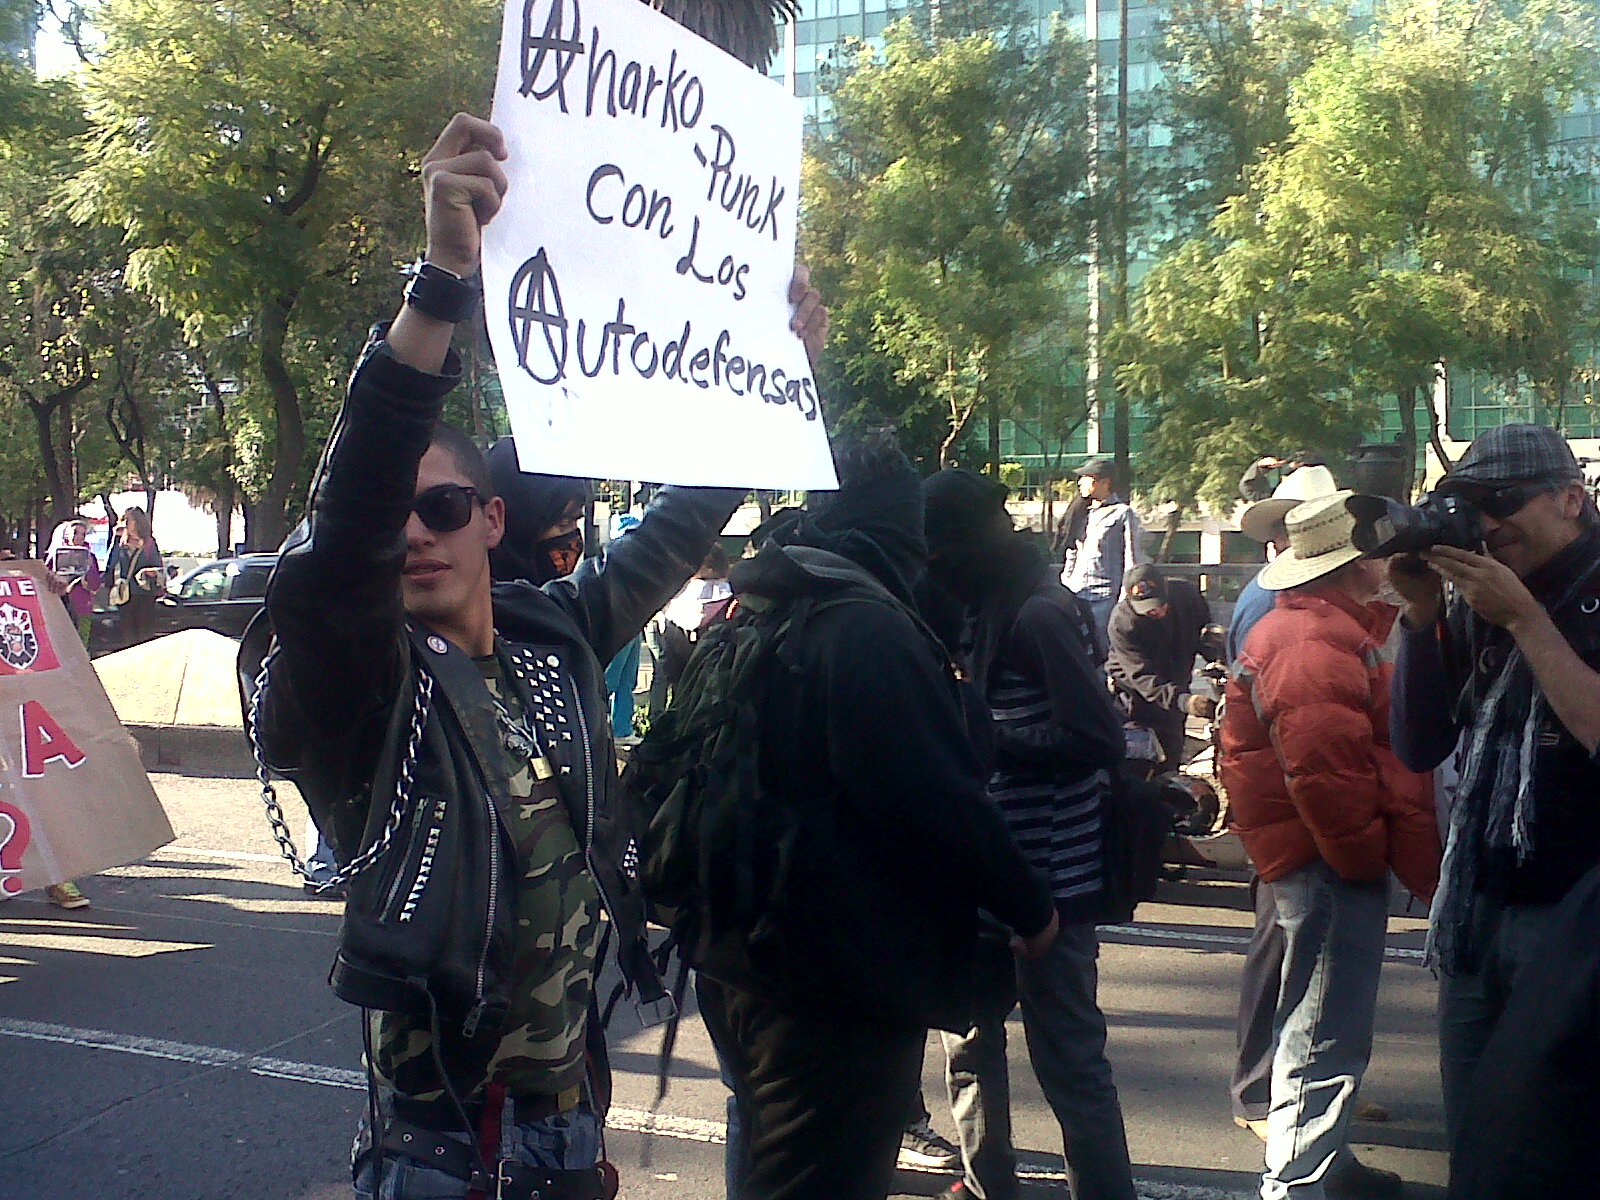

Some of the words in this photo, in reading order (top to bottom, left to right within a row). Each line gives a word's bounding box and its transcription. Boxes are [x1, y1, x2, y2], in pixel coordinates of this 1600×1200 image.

[586, 163, 674, 239] Con
[676, 214, 749, 301] Los
[508, 246, 817, 421] Autodefensas
